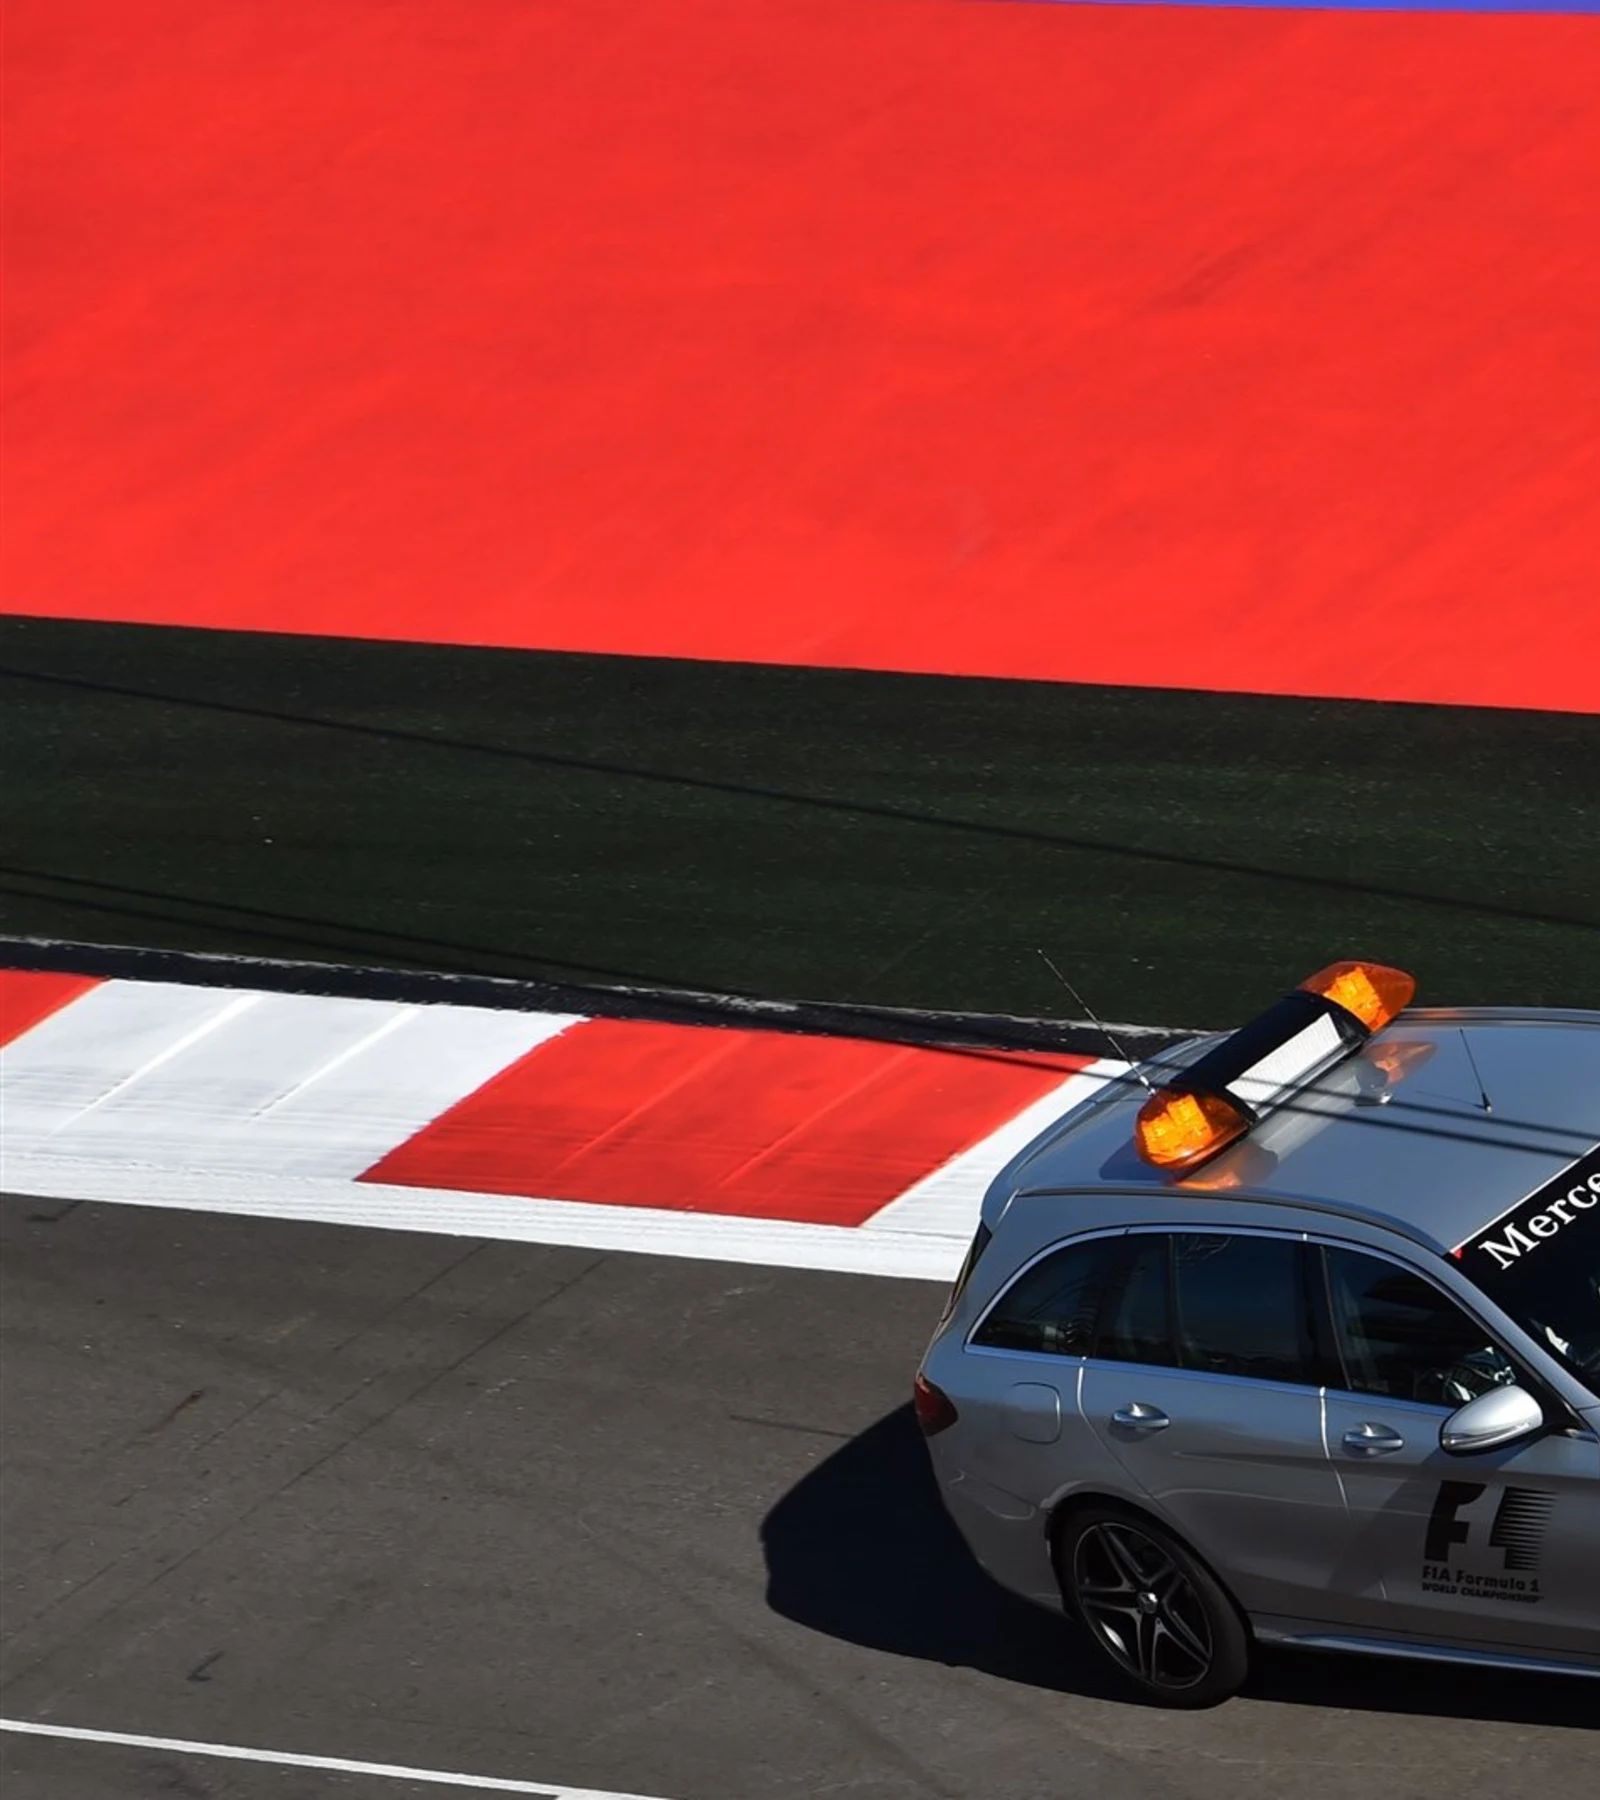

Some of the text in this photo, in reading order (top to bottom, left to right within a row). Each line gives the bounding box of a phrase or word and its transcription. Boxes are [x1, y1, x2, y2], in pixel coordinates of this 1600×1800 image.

[1424, 1479, 1557, 1571] F1
[1421, 1565, 1540, 1592] FIA Formula 1
[1421, 1582, 1458, 1595] WORLD
